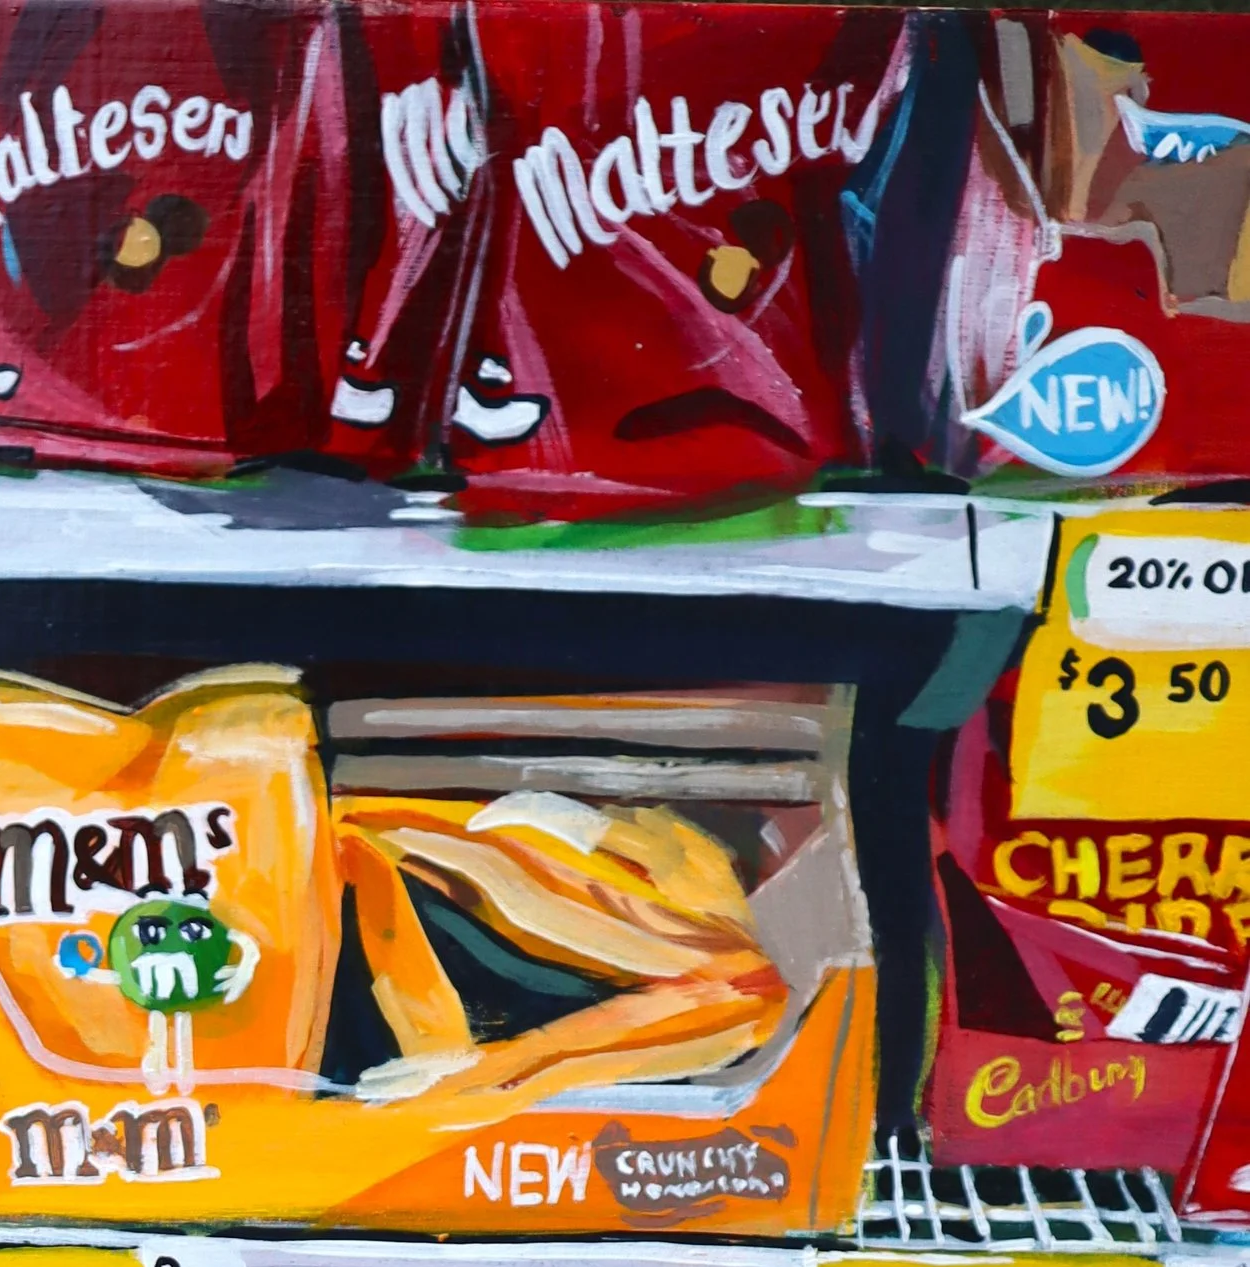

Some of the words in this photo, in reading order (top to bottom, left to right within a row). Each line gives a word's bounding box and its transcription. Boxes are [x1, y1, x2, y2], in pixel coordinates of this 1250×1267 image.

[1020, 372, 1150, 435] NEW!
[1107, 556, 1193, 589] 20%
[965, 1055, 1146, 1128] Cadbury
[463, 1141, 592, 1208] NEW
